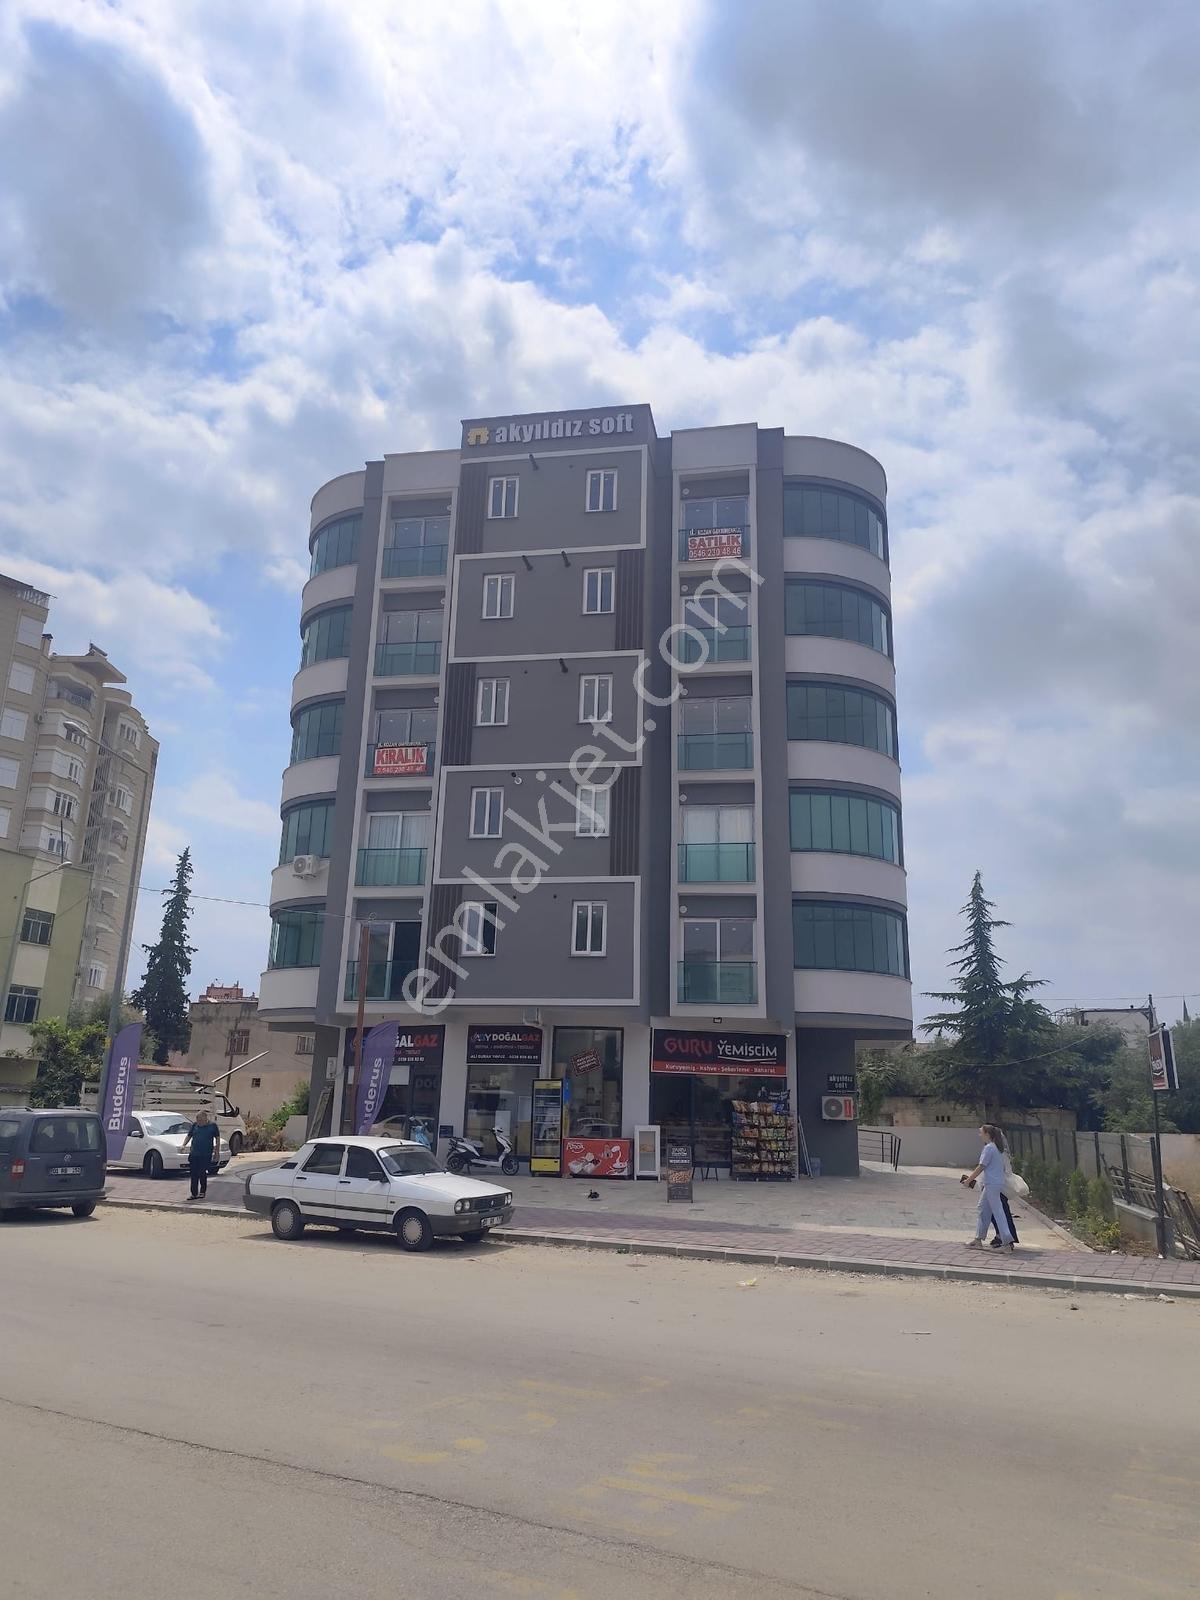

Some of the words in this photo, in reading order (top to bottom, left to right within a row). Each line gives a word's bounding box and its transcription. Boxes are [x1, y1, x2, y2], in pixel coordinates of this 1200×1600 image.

[495, 417, 582, 443] akyıldız
[588, 413, 634, 435] soft
[689, 535, 740, 549] SATILIK
[664, 1038, 712, 1057] GURU
[108, 1057, 128, 1131] Buderus
[363, 1057, 382, 1123] uderus
